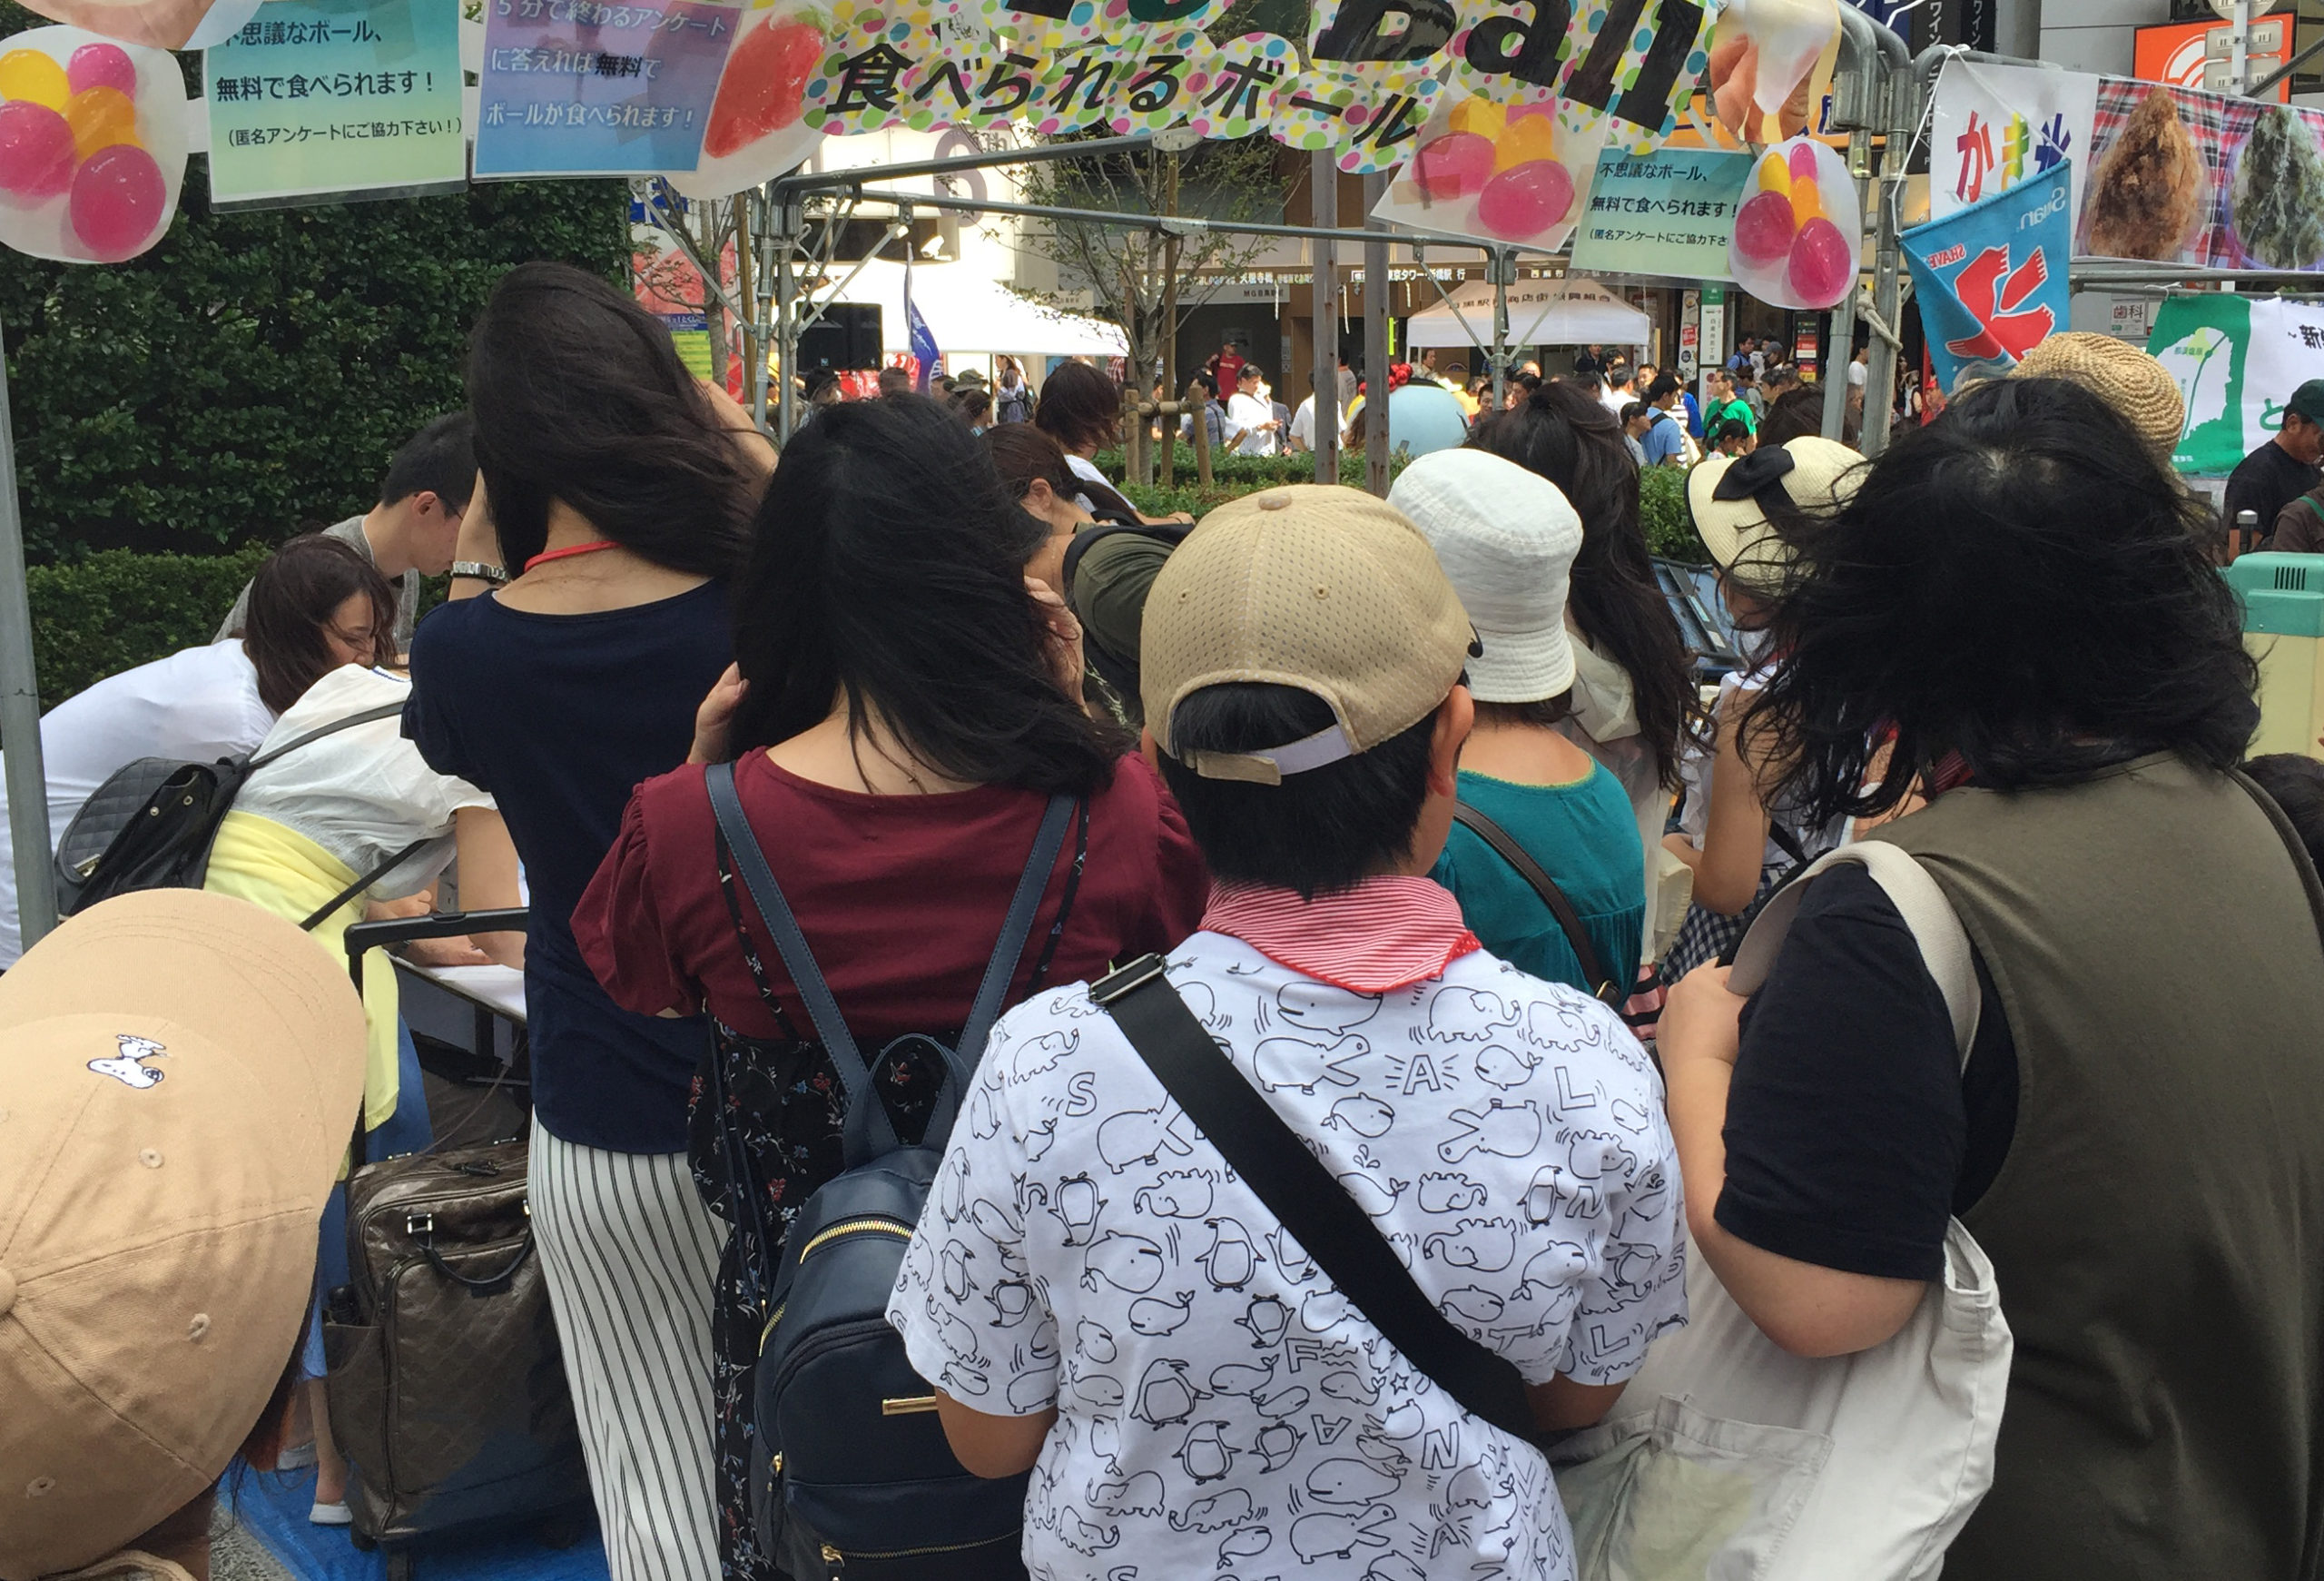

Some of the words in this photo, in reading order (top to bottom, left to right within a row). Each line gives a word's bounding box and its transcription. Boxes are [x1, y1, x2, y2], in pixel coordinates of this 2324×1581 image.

[491, 47, 661, 78] に答えれば無料で
[216, 70, 433, 102] 無料で食べられます！
[825, 43, 1418, 148] 食べられるボール
[487, 102, 694, 128] ボールが食べられます！
[228, 117, 462, 147] （匿名アンケートにご協力下さい！）
[1600, 162, 1708, 182] 不思議なボール、
[1955, 110, 2072, 203] かき氷
[1590, 195, 1737, 219] 無料で食べられます！
[1590, 229, 1729, 247] （匿名アンケートにご協力下さ
[2113, 304, 2143, 319] 歯科
[2299, 324, 2324, 350] 新
[1403, 1054, 1442, 1095] A
[1065, 1072, 1098, 1117] S
[1285, 1338, 1323, 1373] F
[1421, 1421, 1460, 1470] N
